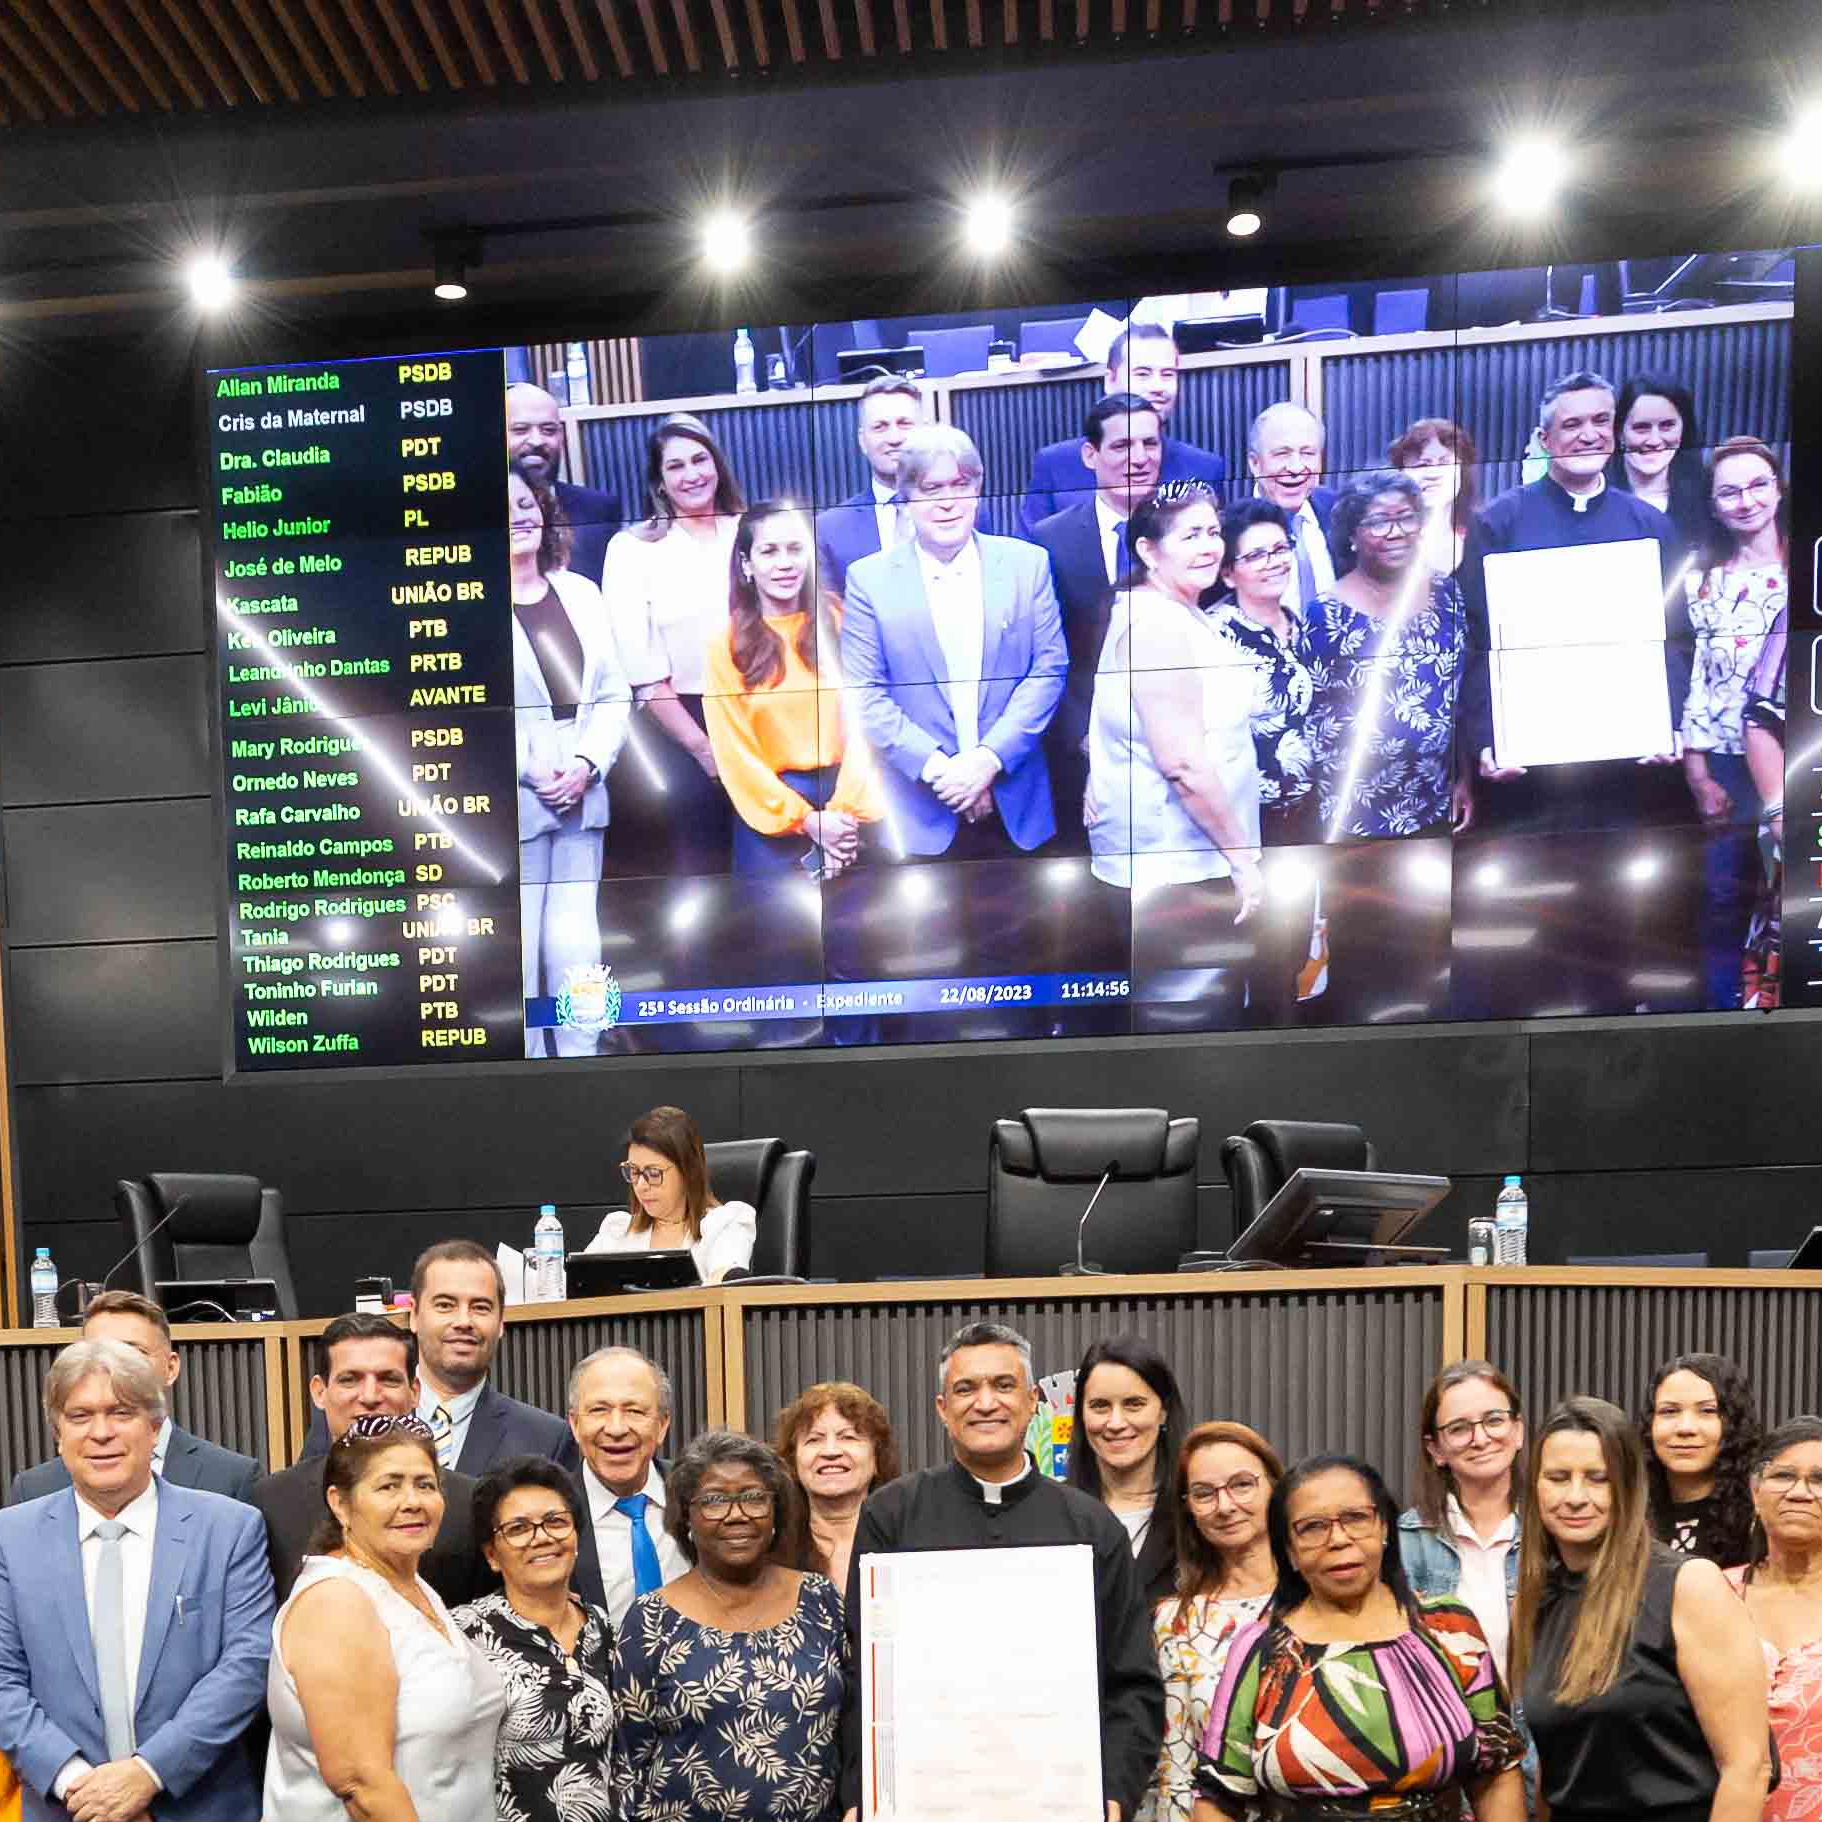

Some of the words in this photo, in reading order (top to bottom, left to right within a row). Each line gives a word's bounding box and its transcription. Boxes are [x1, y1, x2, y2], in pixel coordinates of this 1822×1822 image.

[398, 363, 452, 384] PSDB
[217, 378, 262, 397] Allan
[267, 371, 340, 394] Miranda
[218, 413, 255, 431] Cris
[260, 412, 283, 429] da
[287, 404, 365, 427] Maternal
[400, 399, 453, 419] PSDB
[401, 437, 441, 457] PDT
[220, 452, 258, 470] Dra.
[262, 446, 330, 466] Claudia
[403, 472, 455, 493] PSDB
[221, 484, 282, 505] Fabião
[223, 521, 268, 539] Helio
[273, 516, 330, 536] Junior
[404, 509, 429, 527] PL
[405, 545, 471, 566] REPUB
[224, 557, 267, 578] José
[272, 558, 294, 575] de
[299, 554, 342, 573] Melo
[391, 581, 452, 604] UNIÃO
[457, 582, 484, 600] BR
[227, 595, 298, 615] Kascata
[268, 627, 336, 646] Oliveira
[409, 619, 448, 638] PTB
[331, 658, 390, 676] Dantas
[410, 653, 462, 672] PRTB
[410, 685, 486, 706] AVANTE
[229, 698, 266, 717] Levi
[411, 727, 463, 747] PSDB
[232, 740, 275, 759] Mary
[280, 736, 373, 756] Rodrigue
[233, 773, 298, 791] Ornedo
[303, 771, 358, 788] Neves
[412, 763, 451, 782] PDT
[235, 808, 276, 825] Rafa
[281, 804, 360, 823] Carvalho
[398, 794, 458, 816] UNÃO
[463, 796, 490, 813] BR
[237, 840, 315, 859] Reinaldo
[319, 838, 393, 856] Campos
[415, 832, 452, 850] PTB
[238, 872, 308, 890] Roberto
[313, 868, 405, 887] Mendonça
[416, 864, 442, 881] SD
[239, 901, 310, 921] Rodrigo
[314, 897, 407, 918] Rodrigues
[241, 928, 289, 946] Tania
[403, 917, 463, 938] UNI
[467, 918, 494, 936] BR
[243, 955, 304, 975] Thiago
[308, 951, 400, 972] Rodrigues
[419, 947, 457, 965] PDT
[244, 981, 316, 1000] Toninho
[320, 979, 378, 997] Furlan
[419, 974, 458, 992] PDT
[1061, 980, 1129, 998] 11:14:56
[667, 997, 719, 1015] Sessão
[723, 995, 794, 1013] Ordinária
[816, 991, 904, 1009] Expediente
[940, 984, 1032, 1004] 22/08/2023
[247, 1009, 307, 1027] Wilden
[421, 1002, 458, 1019] PTB
[248, 1037, 308, 1054] Wilson
[313, 1034, 359, 1052] Zuffa
[422, 1028, 486, 1047] REPUB
